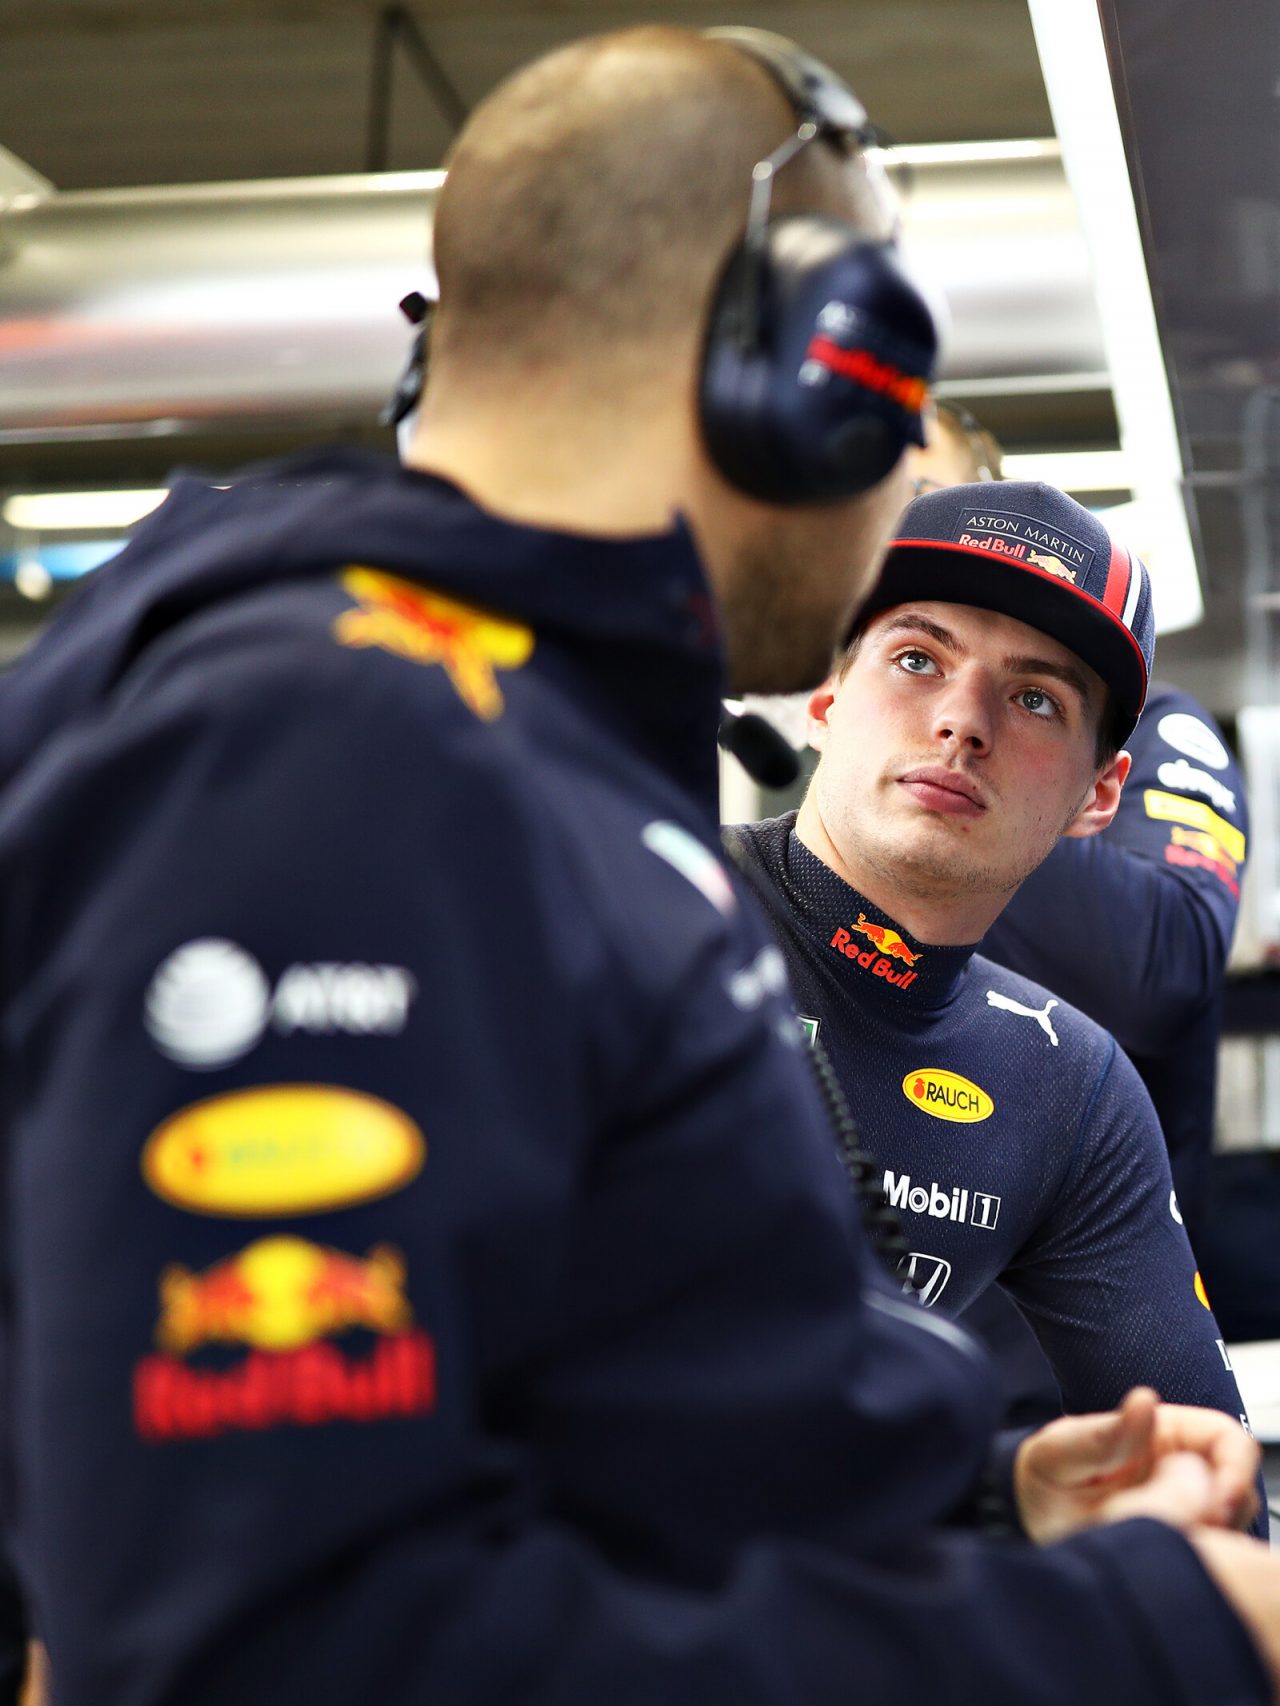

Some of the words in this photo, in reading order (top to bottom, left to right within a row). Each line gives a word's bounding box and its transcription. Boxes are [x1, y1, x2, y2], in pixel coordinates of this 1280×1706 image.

[958, 534, 993, 550] Red
[992, 538, 1027, 559] Bull
[967, 516, 1020, 533] ASTON
[1024, 526, 1085, 563] MARTIN
[830, 927, 879, 969] Red
[872, 958, 918, 990] Bull
[926, 1081, 979, 1113] RAUCH
[883, 1169, 968, 1223] Mobil
